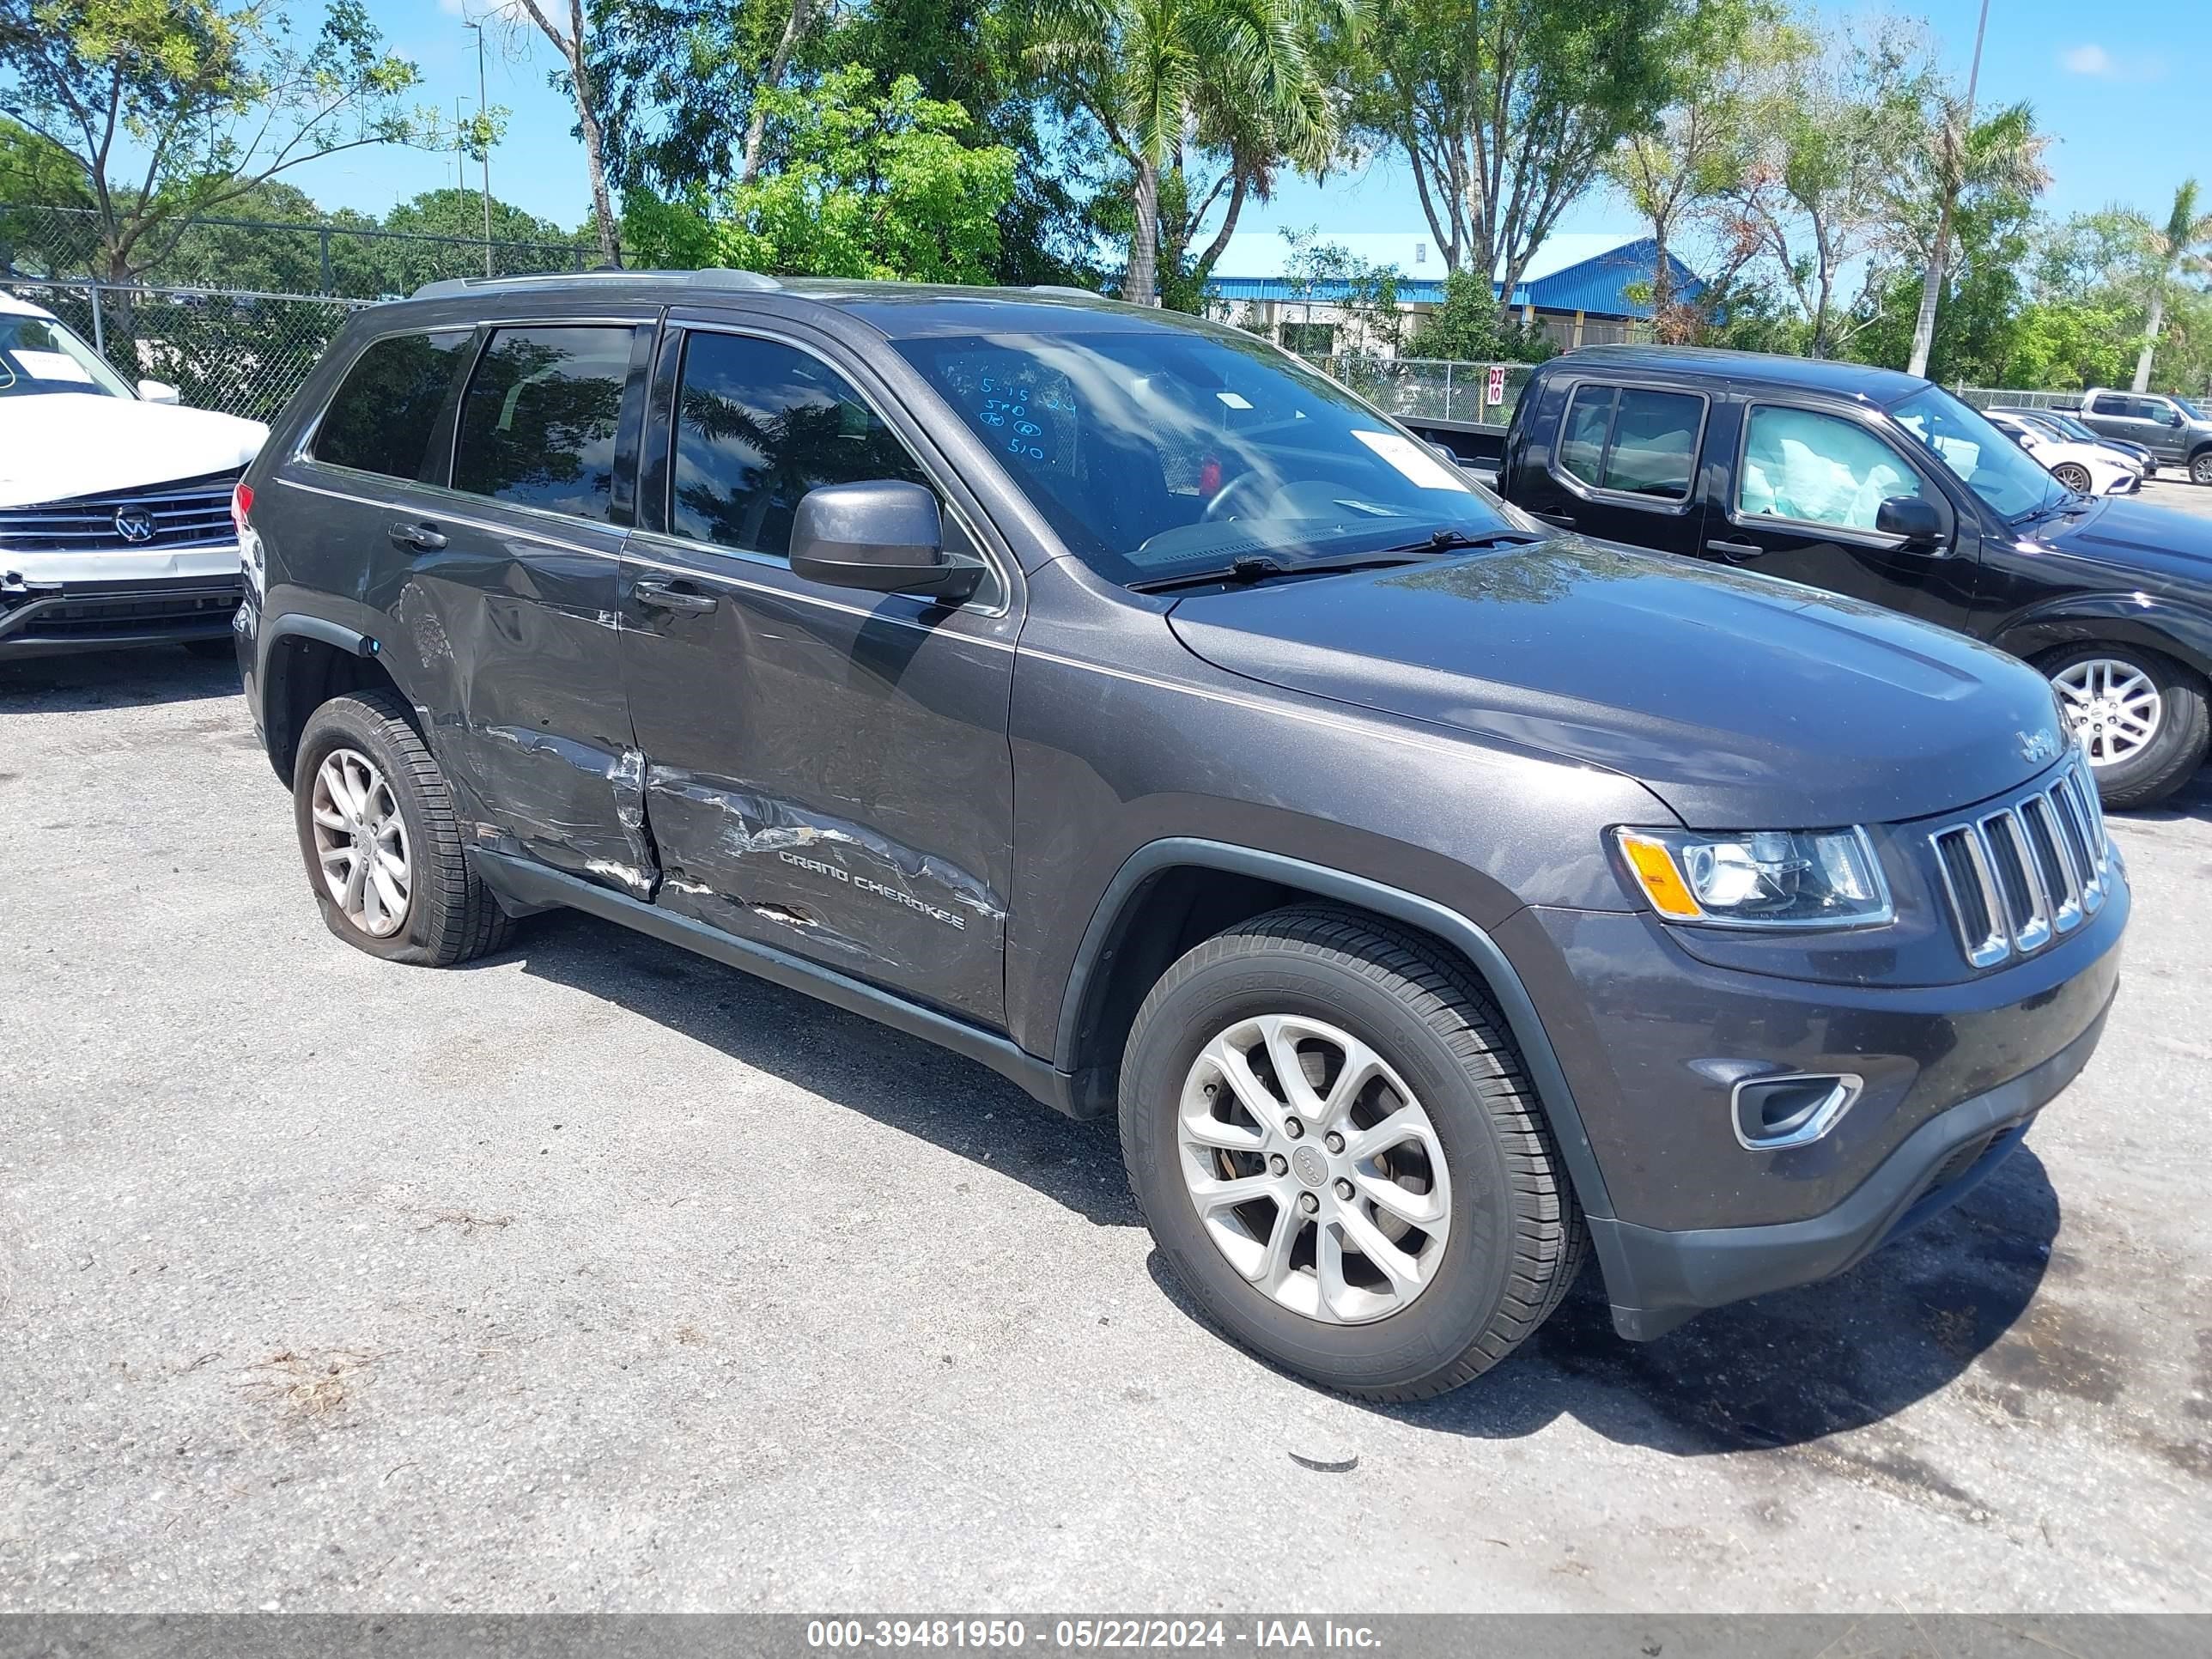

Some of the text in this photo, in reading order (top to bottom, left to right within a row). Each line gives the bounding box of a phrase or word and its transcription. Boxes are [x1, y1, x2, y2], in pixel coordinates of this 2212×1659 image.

[1490, 369, 1504, 385] DZ
[779, 851, 967, 931] GRAND CHEROKEE
